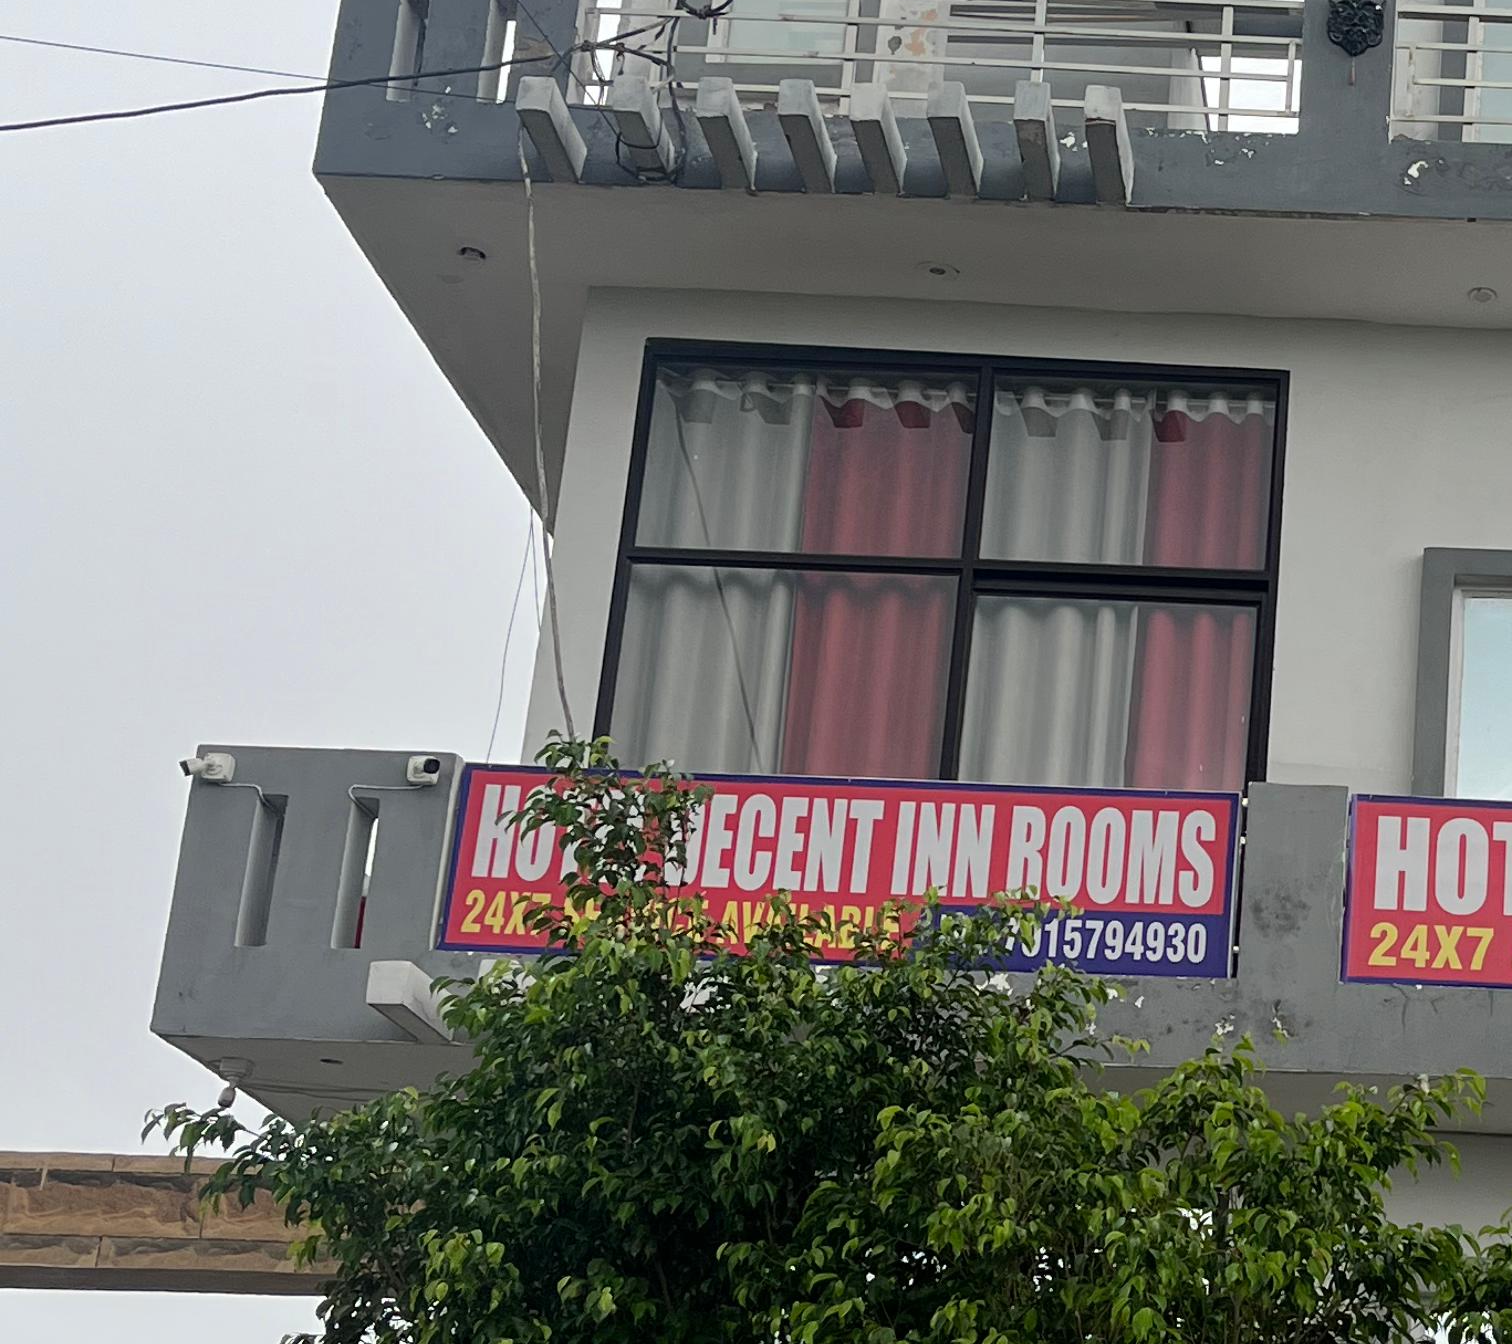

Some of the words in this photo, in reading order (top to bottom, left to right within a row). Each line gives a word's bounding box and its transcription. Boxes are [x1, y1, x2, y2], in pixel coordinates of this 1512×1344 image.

[664, 792, 884, 894] DECENT
[890, 802, 995, 899] INN
[1007, 805, 1216, 907] ROOMS
[1367, 922, 1494, 971] 24X7
